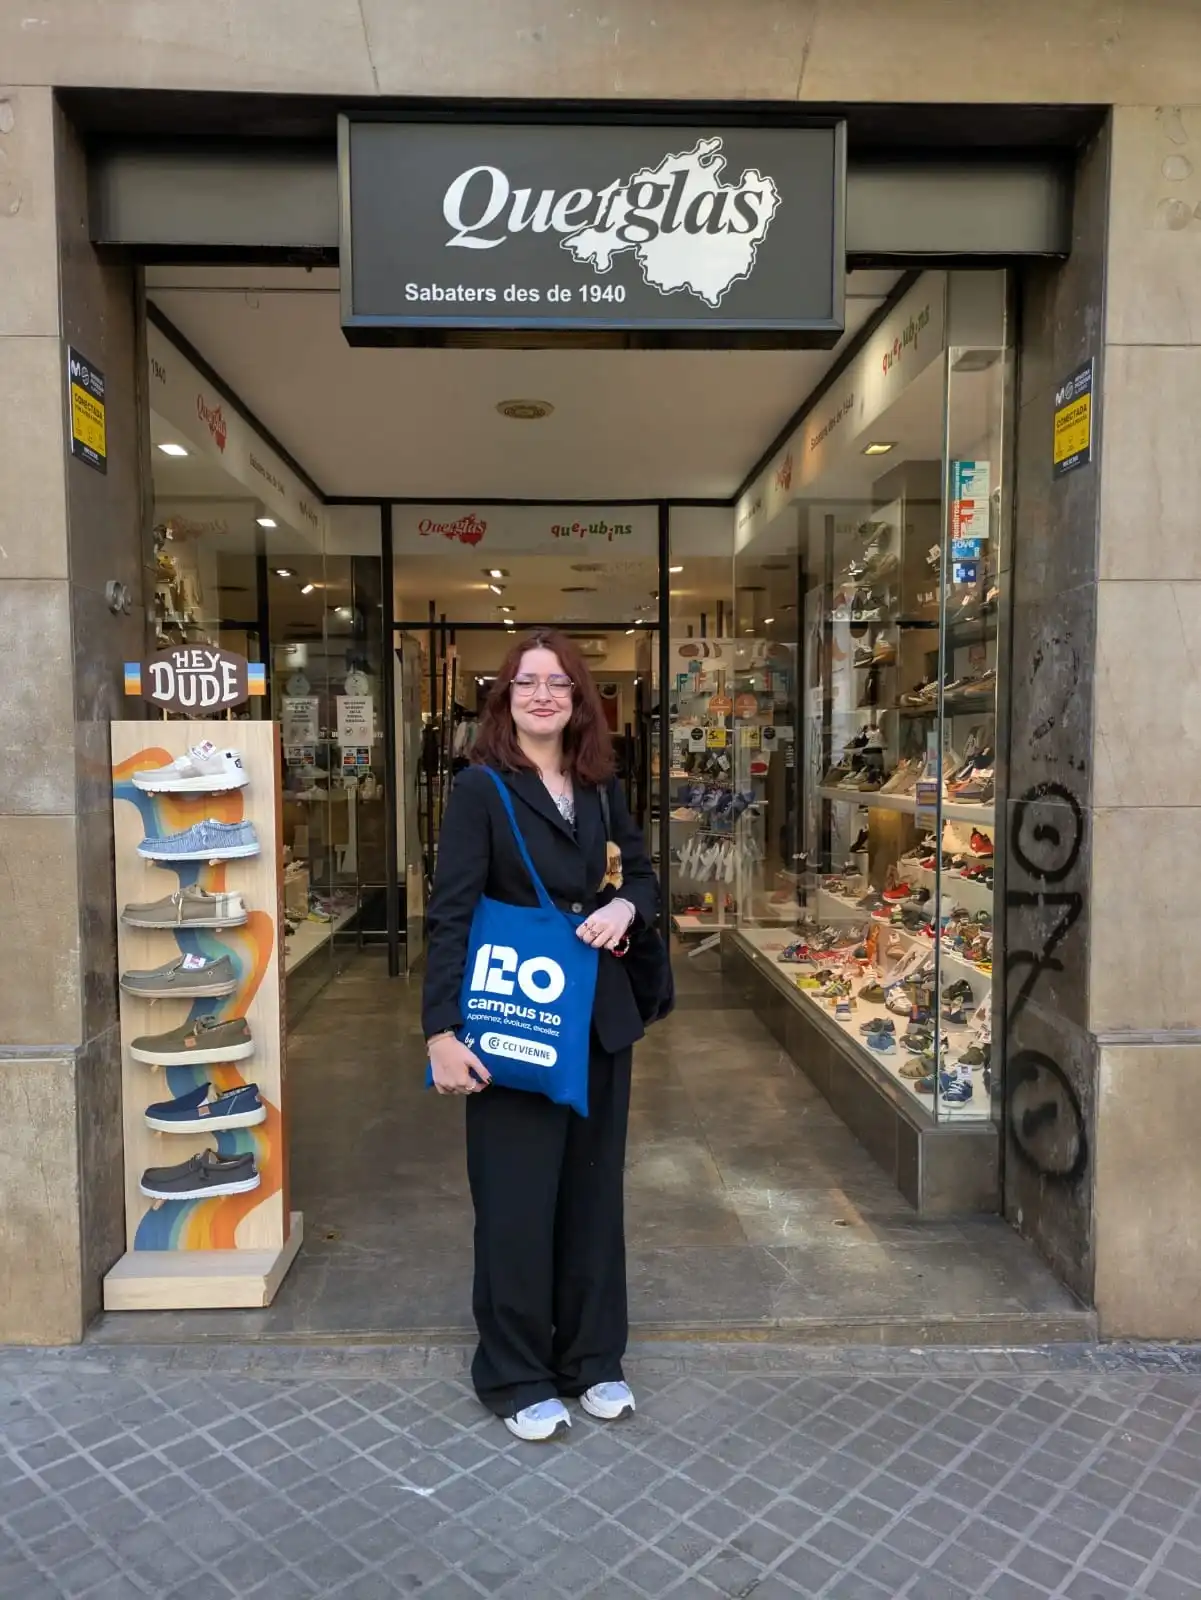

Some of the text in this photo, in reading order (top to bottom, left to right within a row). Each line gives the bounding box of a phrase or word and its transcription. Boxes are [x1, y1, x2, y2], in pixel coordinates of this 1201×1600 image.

[443, 165, 763, 249] Quetglas
[405, 283, 626, 303] Sabaters des de 1940
[551, 520, 632, 542] querubins
[172, 650, 221, 672] HEY
[149, 661, 239, 707] DUDE
[470, 943, 566, 1004] 120
[467, 998, 562, 1027] campus 120
[502, 1041, 551, 1061] CCI VIENNE
